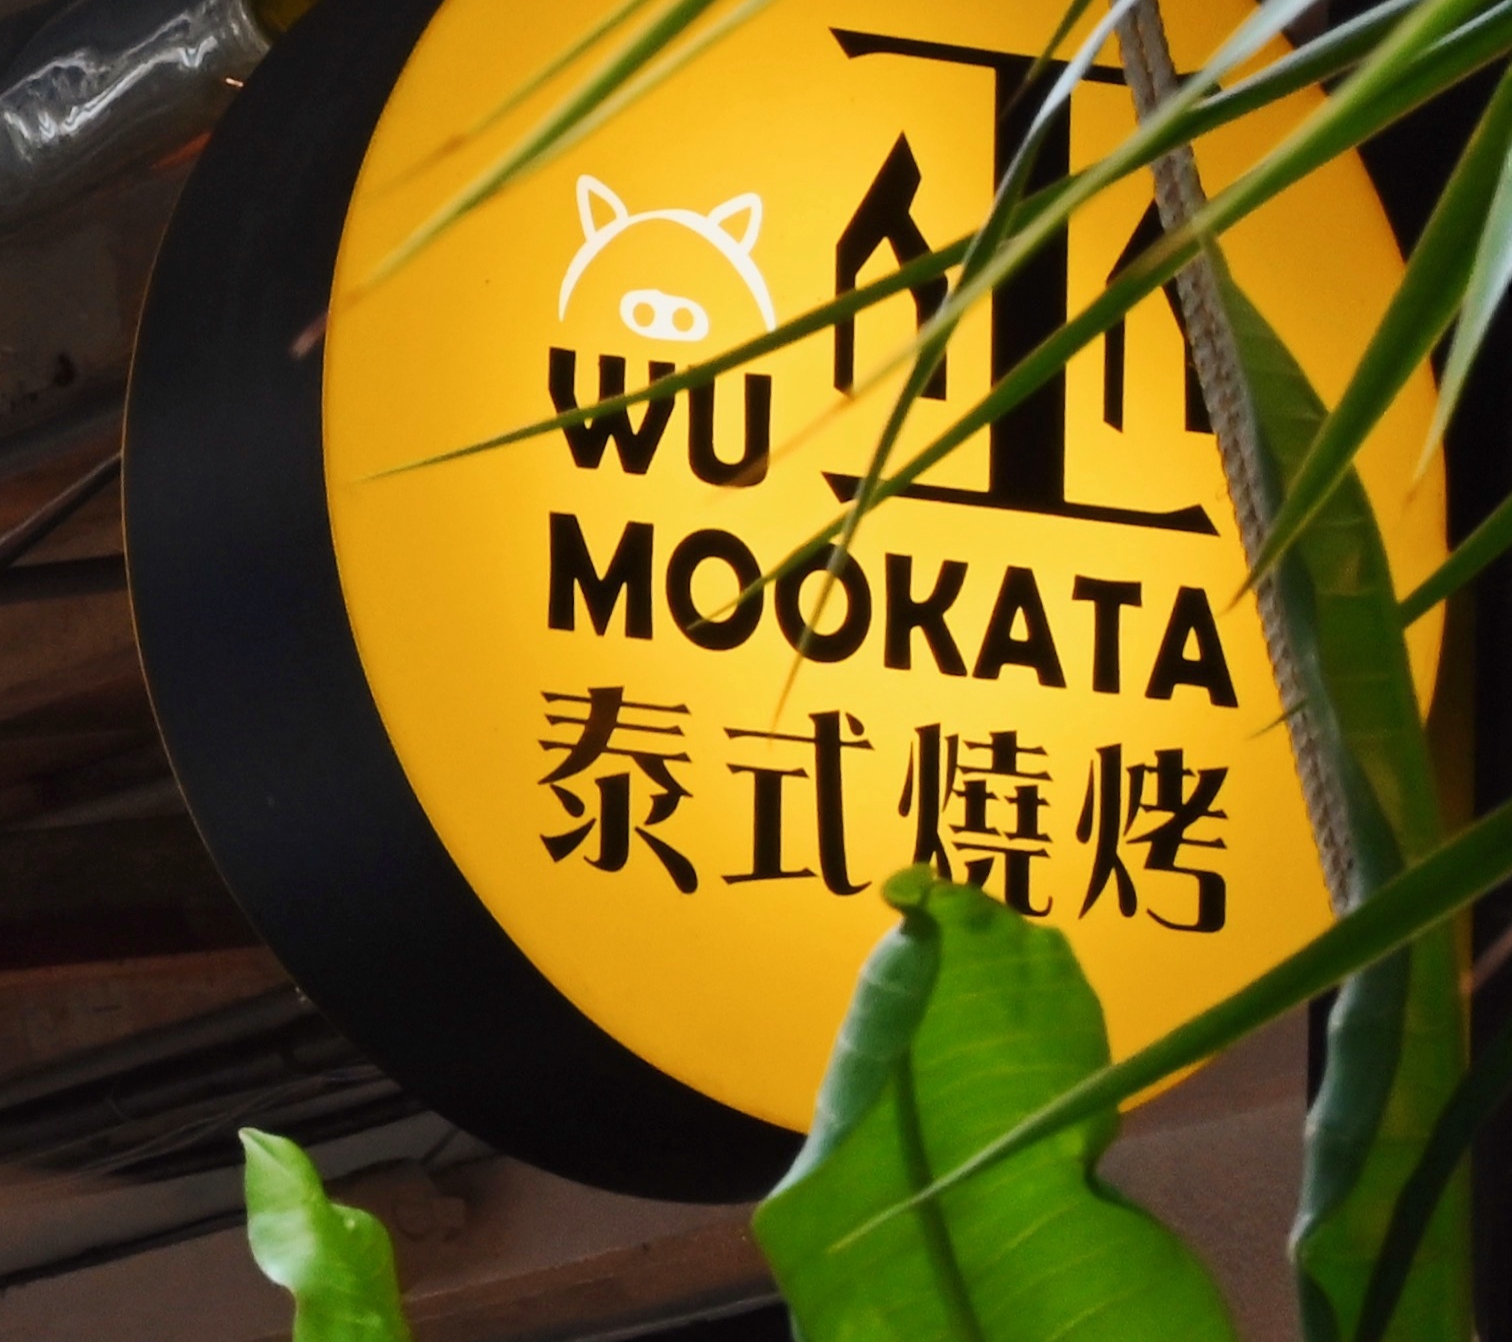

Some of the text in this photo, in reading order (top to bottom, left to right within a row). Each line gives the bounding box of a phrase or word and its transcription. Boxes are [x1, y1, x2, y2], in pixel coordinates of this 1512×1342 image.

[547, 346, 773, 487] WU
[547, 511, 1239, 709] MOOKATA
[539, 685, 1232, 935] 泰式燒烤
